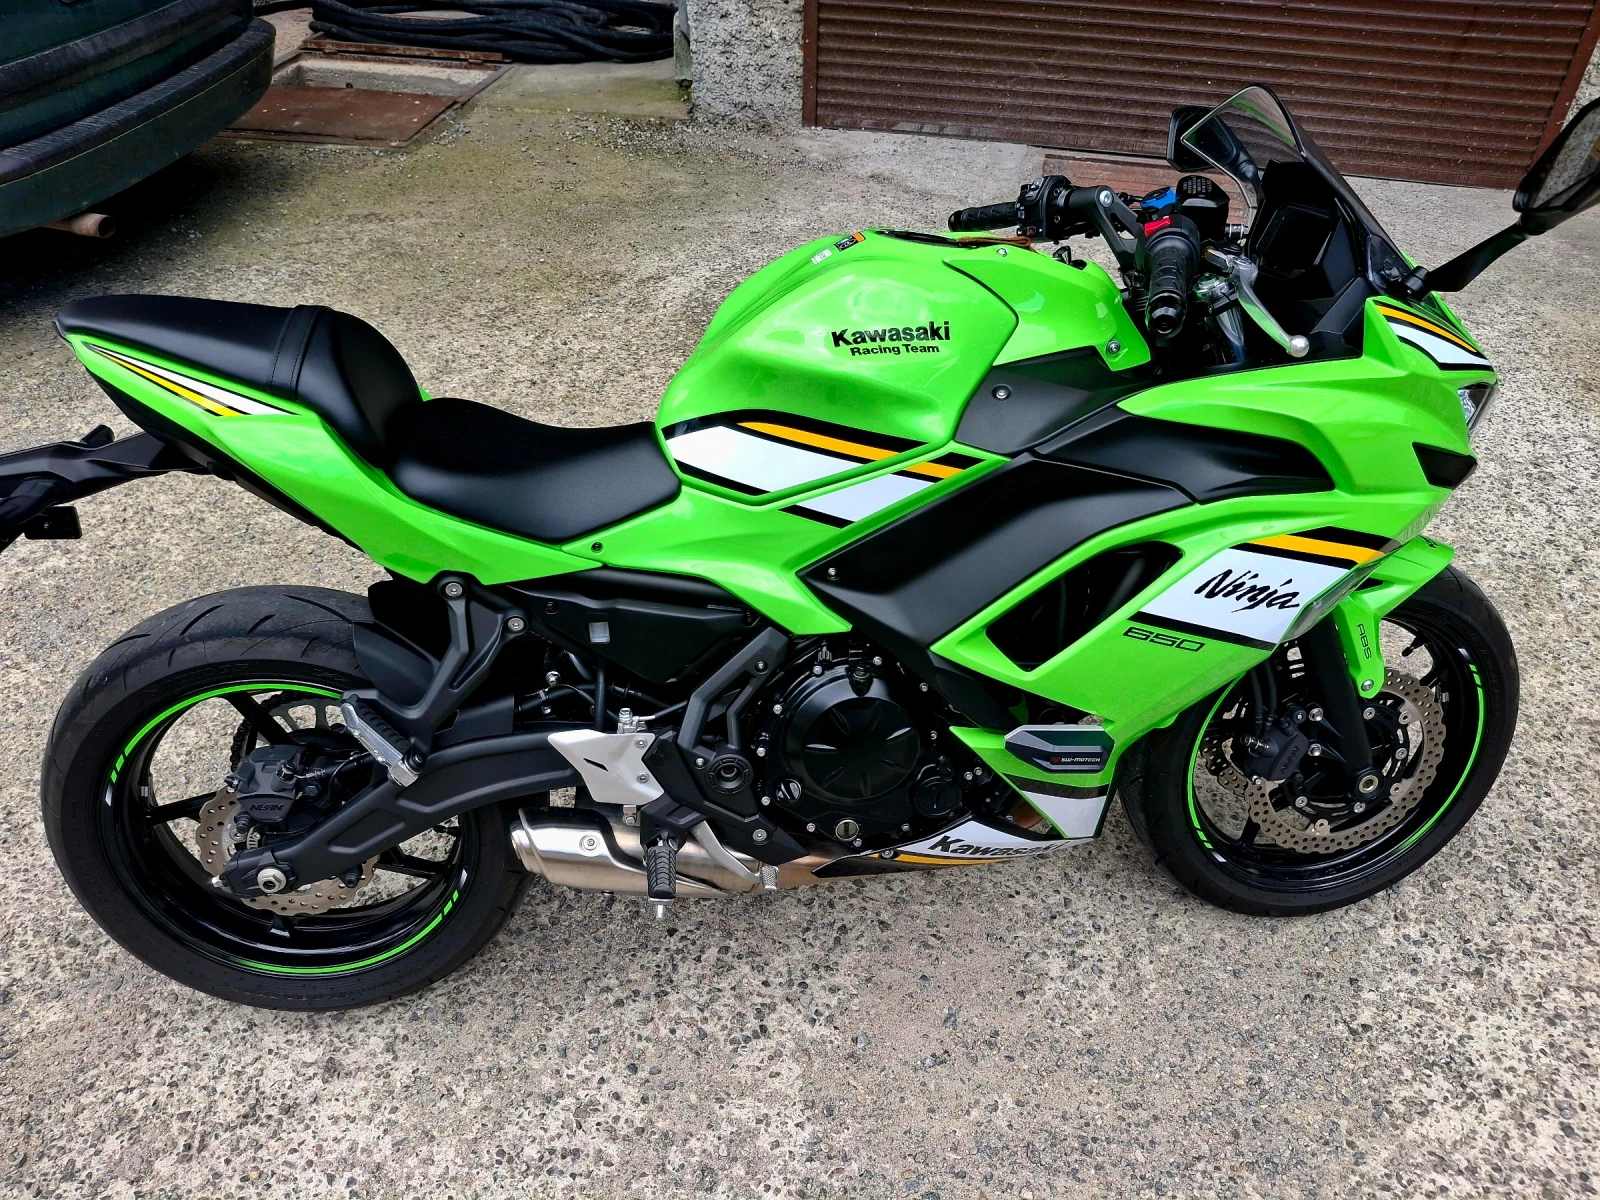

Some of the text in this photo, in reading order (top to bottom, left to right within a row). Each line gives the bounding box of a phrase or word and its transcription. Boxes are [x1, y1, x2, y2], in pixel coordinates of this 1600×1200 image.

[831, 321, 950, 347] Kawasaki
[850, 343, 940, 356] Racing Team
[1194, 569, 1300, 613] Ninja
[1123, 626, 1205, 652] 650
[1357, 623, 1372, 659] ABS
